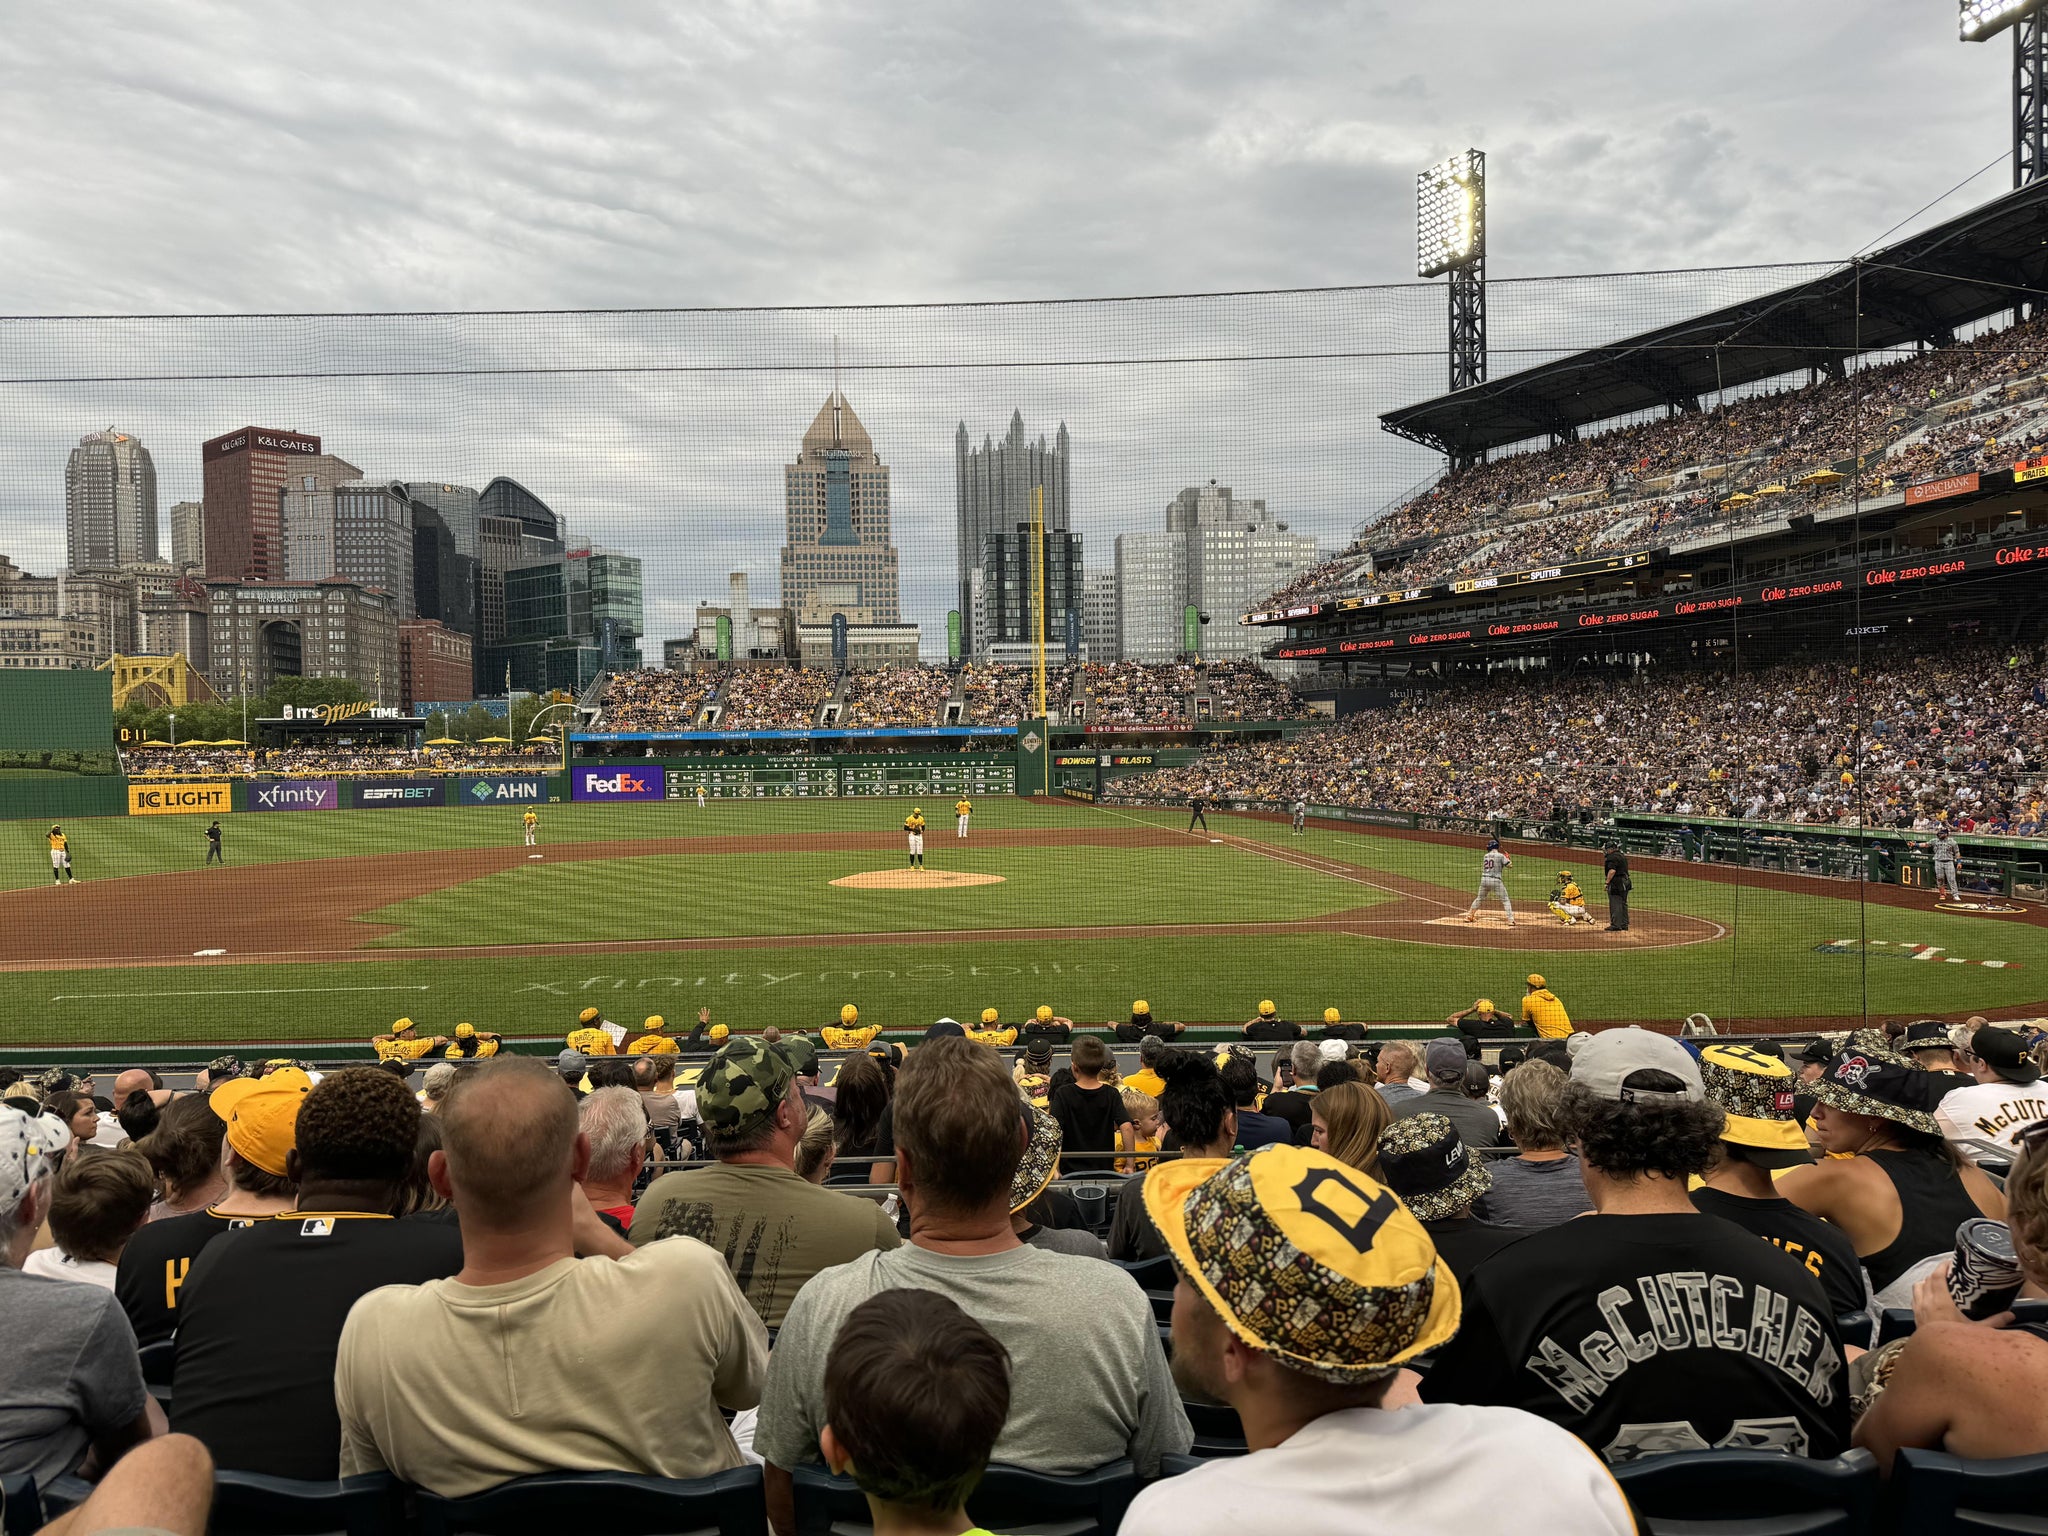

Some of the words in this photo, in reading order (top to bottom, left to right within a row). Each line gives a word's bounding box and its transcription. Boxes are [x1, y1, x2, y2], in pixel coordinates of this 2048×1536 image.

[230, 436, 246, 450] GATES
[257, 436, 280, 448] K&L
[280, 440, 314, 453] GATES
[2025, 458, 2042, 468] METS
[2021, 467, 2047, 480] PIRATES
[1924, 482, 1944, 495] PNC
[1943, 476, 1969, 491] BANK
[1995, 546, 2033, 566] Coke
[1530, 568, 1562, 581] SPLITTER
[1866, 569, 1897, 586] Coke
[1899, 567, 1927, 580] ZERO
[1928, 561, 1966, 575] SUGAR
[1474, 577, 1498, 590] SKENES
[1761, 587, 1787, 602] Coke
[1788, 586, 1811, 598] ZERO
[1812, 580, 1843, 593] SUGAR
[1675, 601, 1696, 615] Coke
[1697, 601, 1717, 611] ZERO
[1717, 596, 1743, 608] SUGAR
[1578, 613, 1604, 627] Coke
[1606, 613, 1629, 623] ZERO
[1630, 610, 1659, 621] SUGAR
[1488, 624, 1511, 636] Coke
[1512, 623, 1532, 633] ZERO
[1533, 621, 1559, 632] SUGAR
[1409, 633, 1429, 645] Coke
[1430, 633, 1447, 642] ZERO
[1448, 630, 1471, 640] SUGAR
[1279, 649, 1295, 658] Coke
[1295, 649, 1308, 657] ZERO
[1309, 647, 1327, 656] SUGAR
[1340, 641, 1357, 652] Coke
[1358, 641, 1374, 650] ZERO
[1374, 639, 1394, 648] SUGAR
[1389, 688, 1413, 698] skull
[296, 708, 319, 718] IT'S
[315, 699, 378, 726] Miller
[370, 707, 399, 718] TIME
[121, 728, 147, 741] 0:11
[1061, 757, 1097, 765] BOWSER
[1119, 756, 1152, 764] BLASTS
[586, 773, 646, 793] FedEx
[165, 790, 223, 806] LIGHT
[258, 785, 328, 808] xfinity
[363, 788, 404, 800] ESPN
[404, 787, 435, 798] BET
[496, 783, 538, 799] AHN
[1483, 860, 1495, 869] 20
[514, 970, 803, 995] xfinity
[2018, 1051, 2027, 1064] P
[1974, 1098, 2048, 1138] McCUTC
